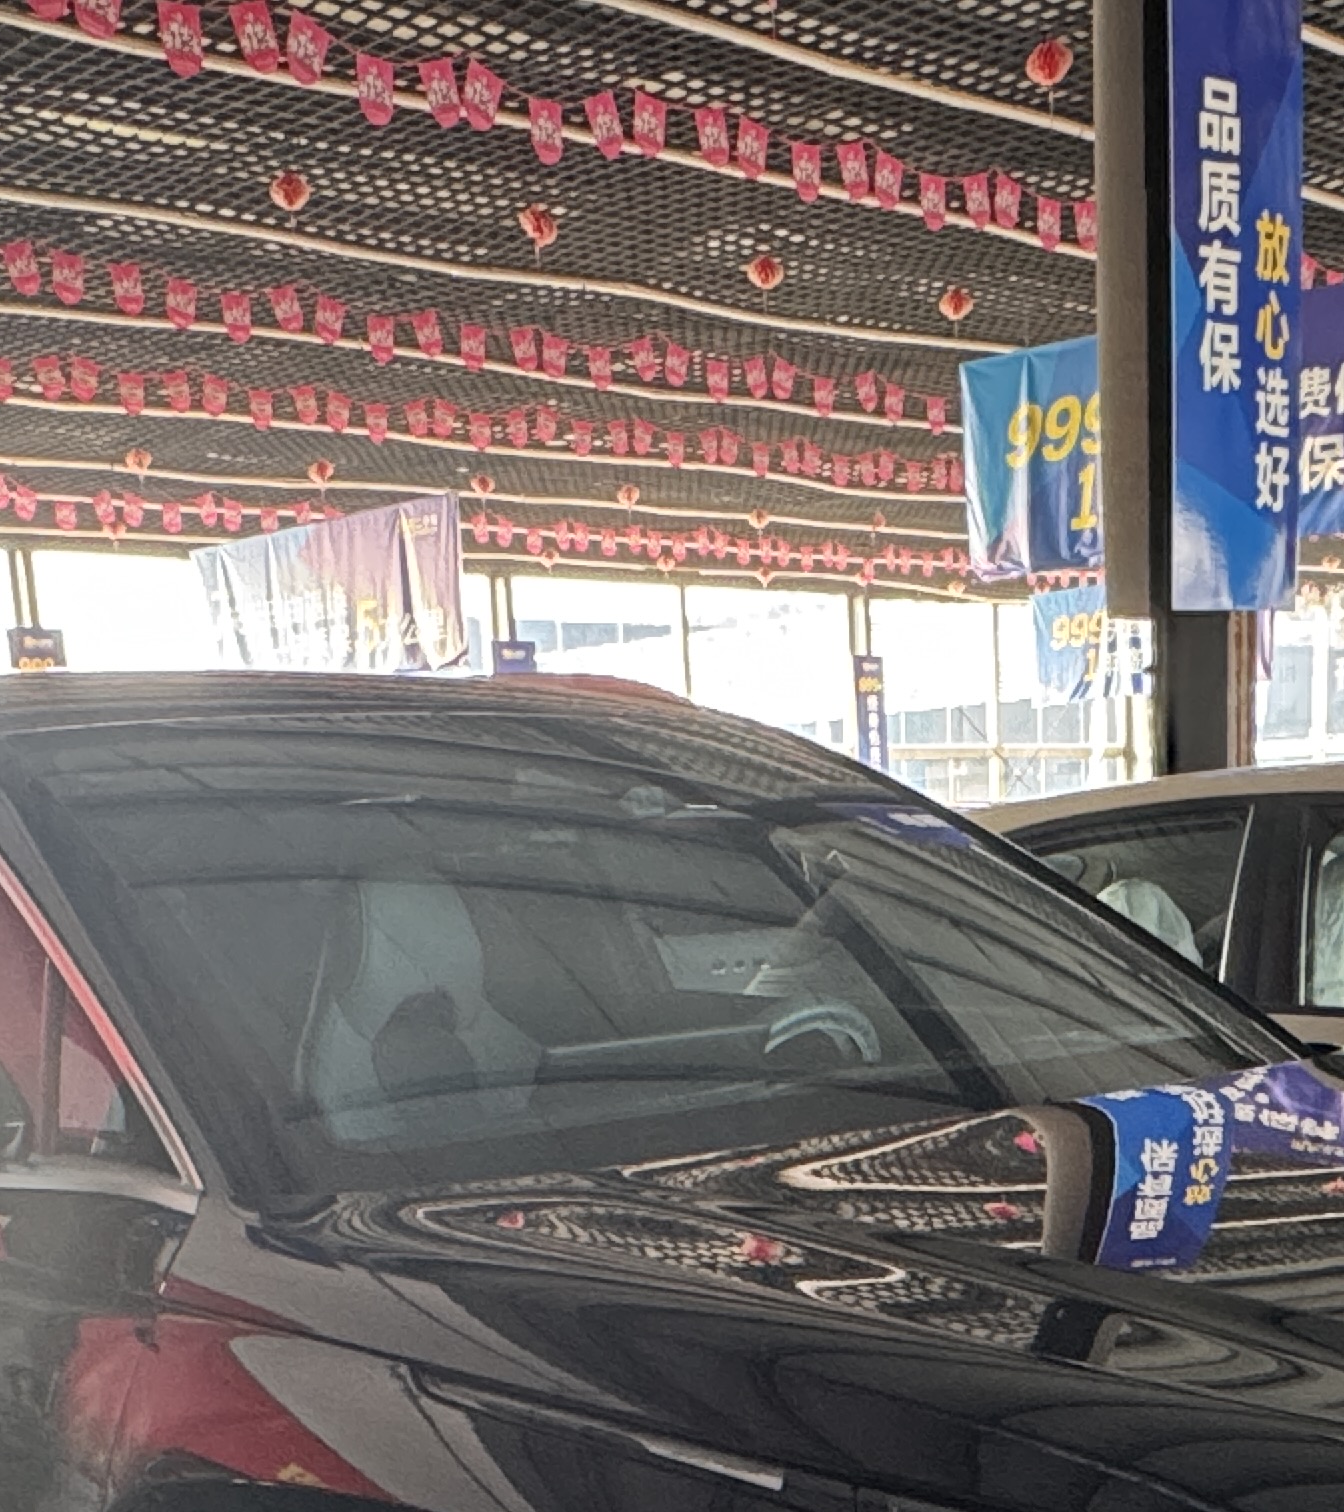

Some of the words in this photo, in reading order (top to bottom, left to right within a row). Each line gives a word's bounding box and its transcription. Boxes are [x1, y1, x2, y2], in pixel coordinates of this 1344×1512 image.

[1197, 76, 1242, 395] 品质有保
[1255, 208, 1292, 514] 放心选好
